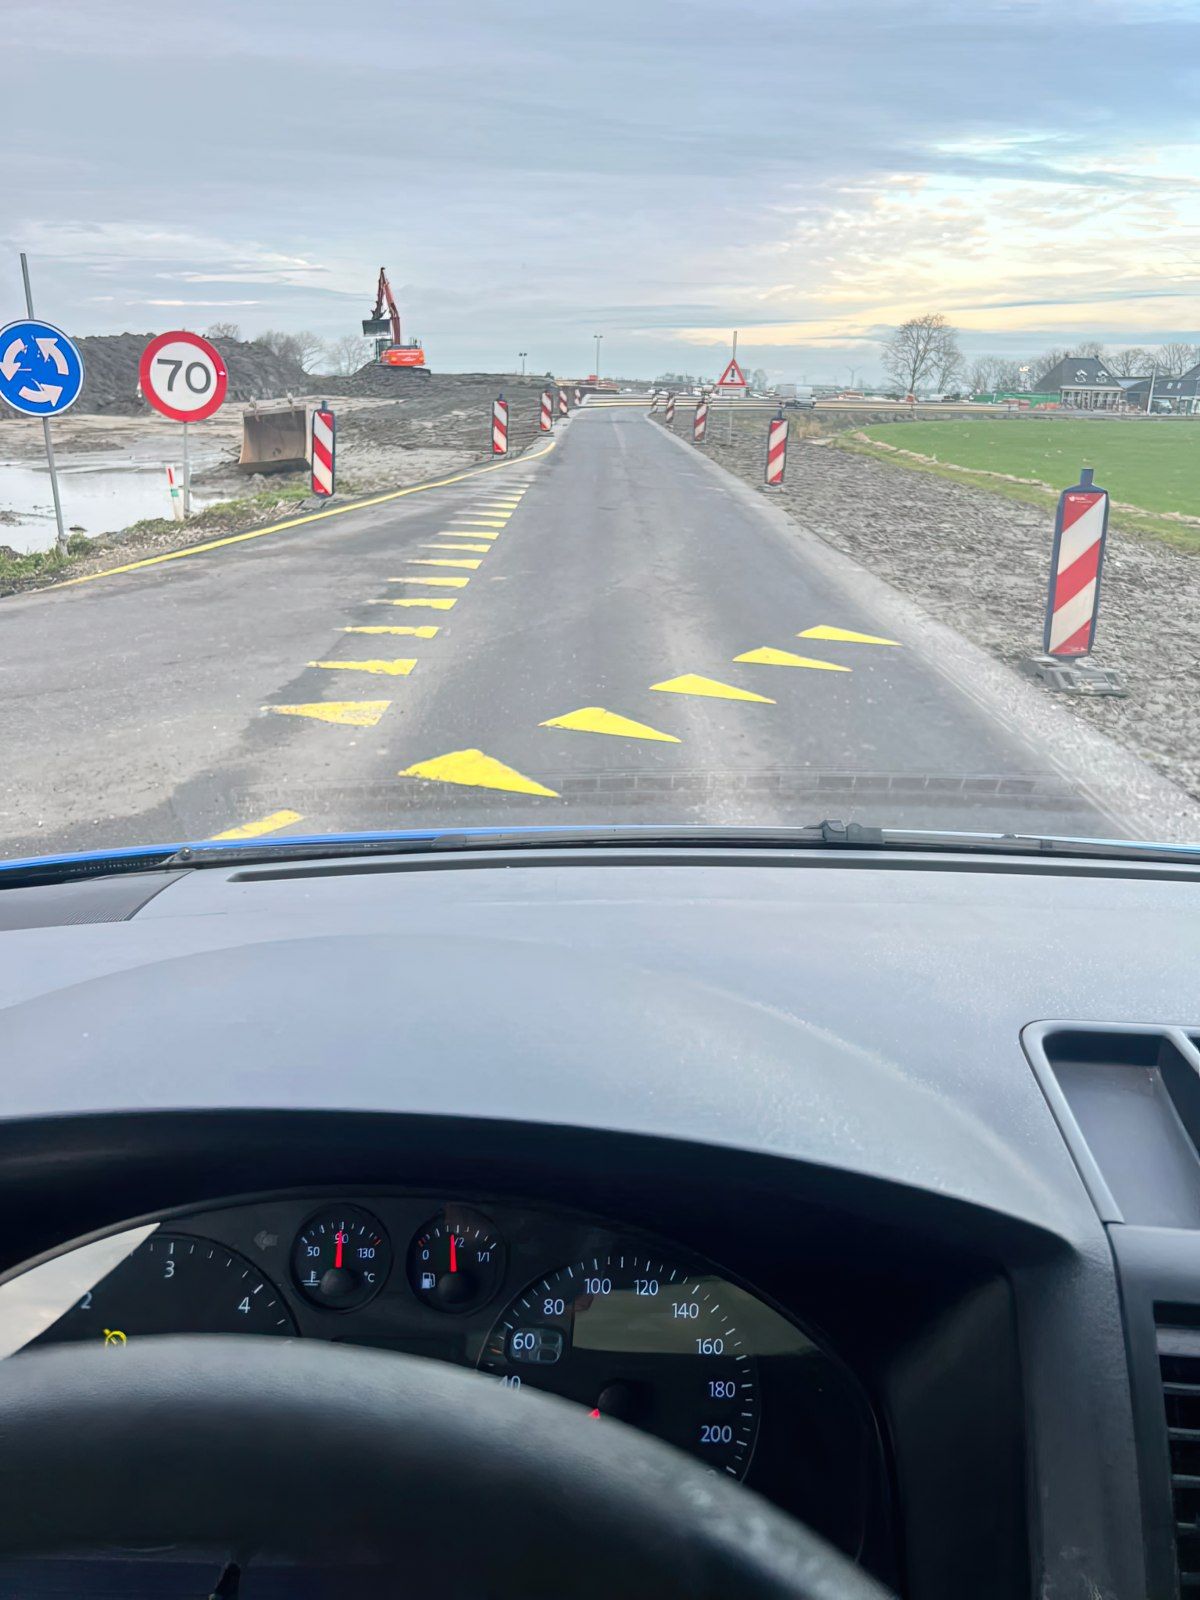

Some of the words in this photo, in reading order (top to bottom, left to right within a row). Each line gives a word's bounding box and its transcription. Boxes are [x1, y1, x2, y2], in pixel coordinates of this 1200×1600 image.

[157, 358, 211, 394] 70
[306, 1246, 320, 1257] 50
[358, 1247, 375, 1259] 130
[422, 1250, 430, 1261] 0
[477, 1251, 491, 1262] 1/1
[164, 1261, 175, 1278] 3
[584, 1278, 612, 1295] 100
[634, 1279, 659, 1296] 120
[81, 1291, 93, 1309] 2
[238, 1297, 250, 1314] 4
[543, 1299, 565, 1315] 80
[672, 1302, 700, 1319] 140
[513, 1333, 535, 1350] 60
[696, 1338, 724, 1355] 160
[708, 1381, 736, 1398] 180
[701, 1426, 732, 1443] 200
